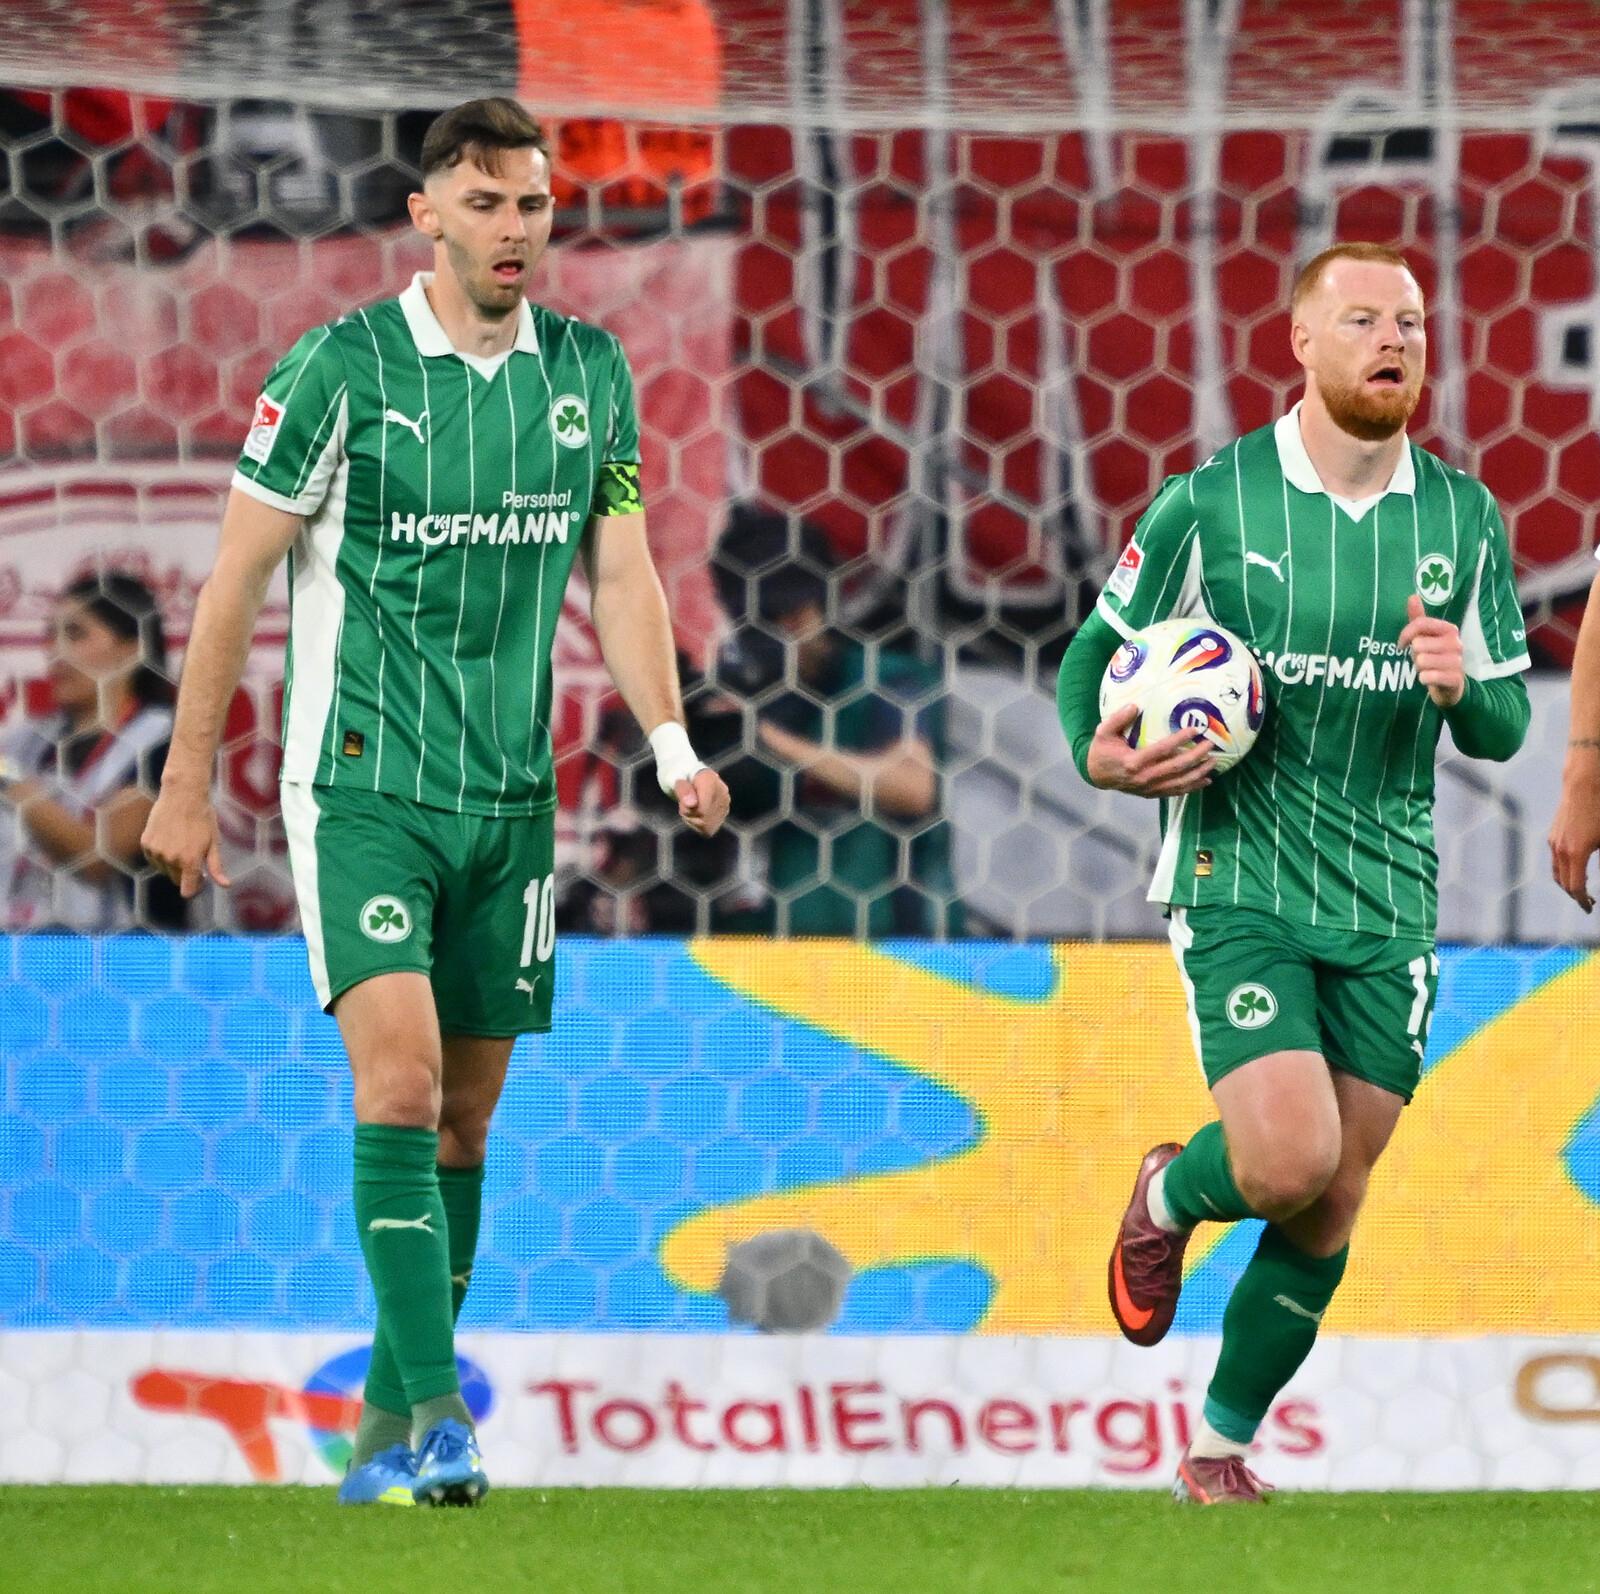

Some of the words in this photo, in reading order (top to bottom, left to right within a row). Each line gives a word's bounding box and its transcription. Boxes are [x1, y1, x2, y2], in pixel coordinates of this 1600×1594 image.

[502, 489, 572, 509] Personal
[519, 872, 556, 968] 10
[1406, 951, 1440, 1036] 1
[526, 1377, 1329, 1475] TotalEnergis
